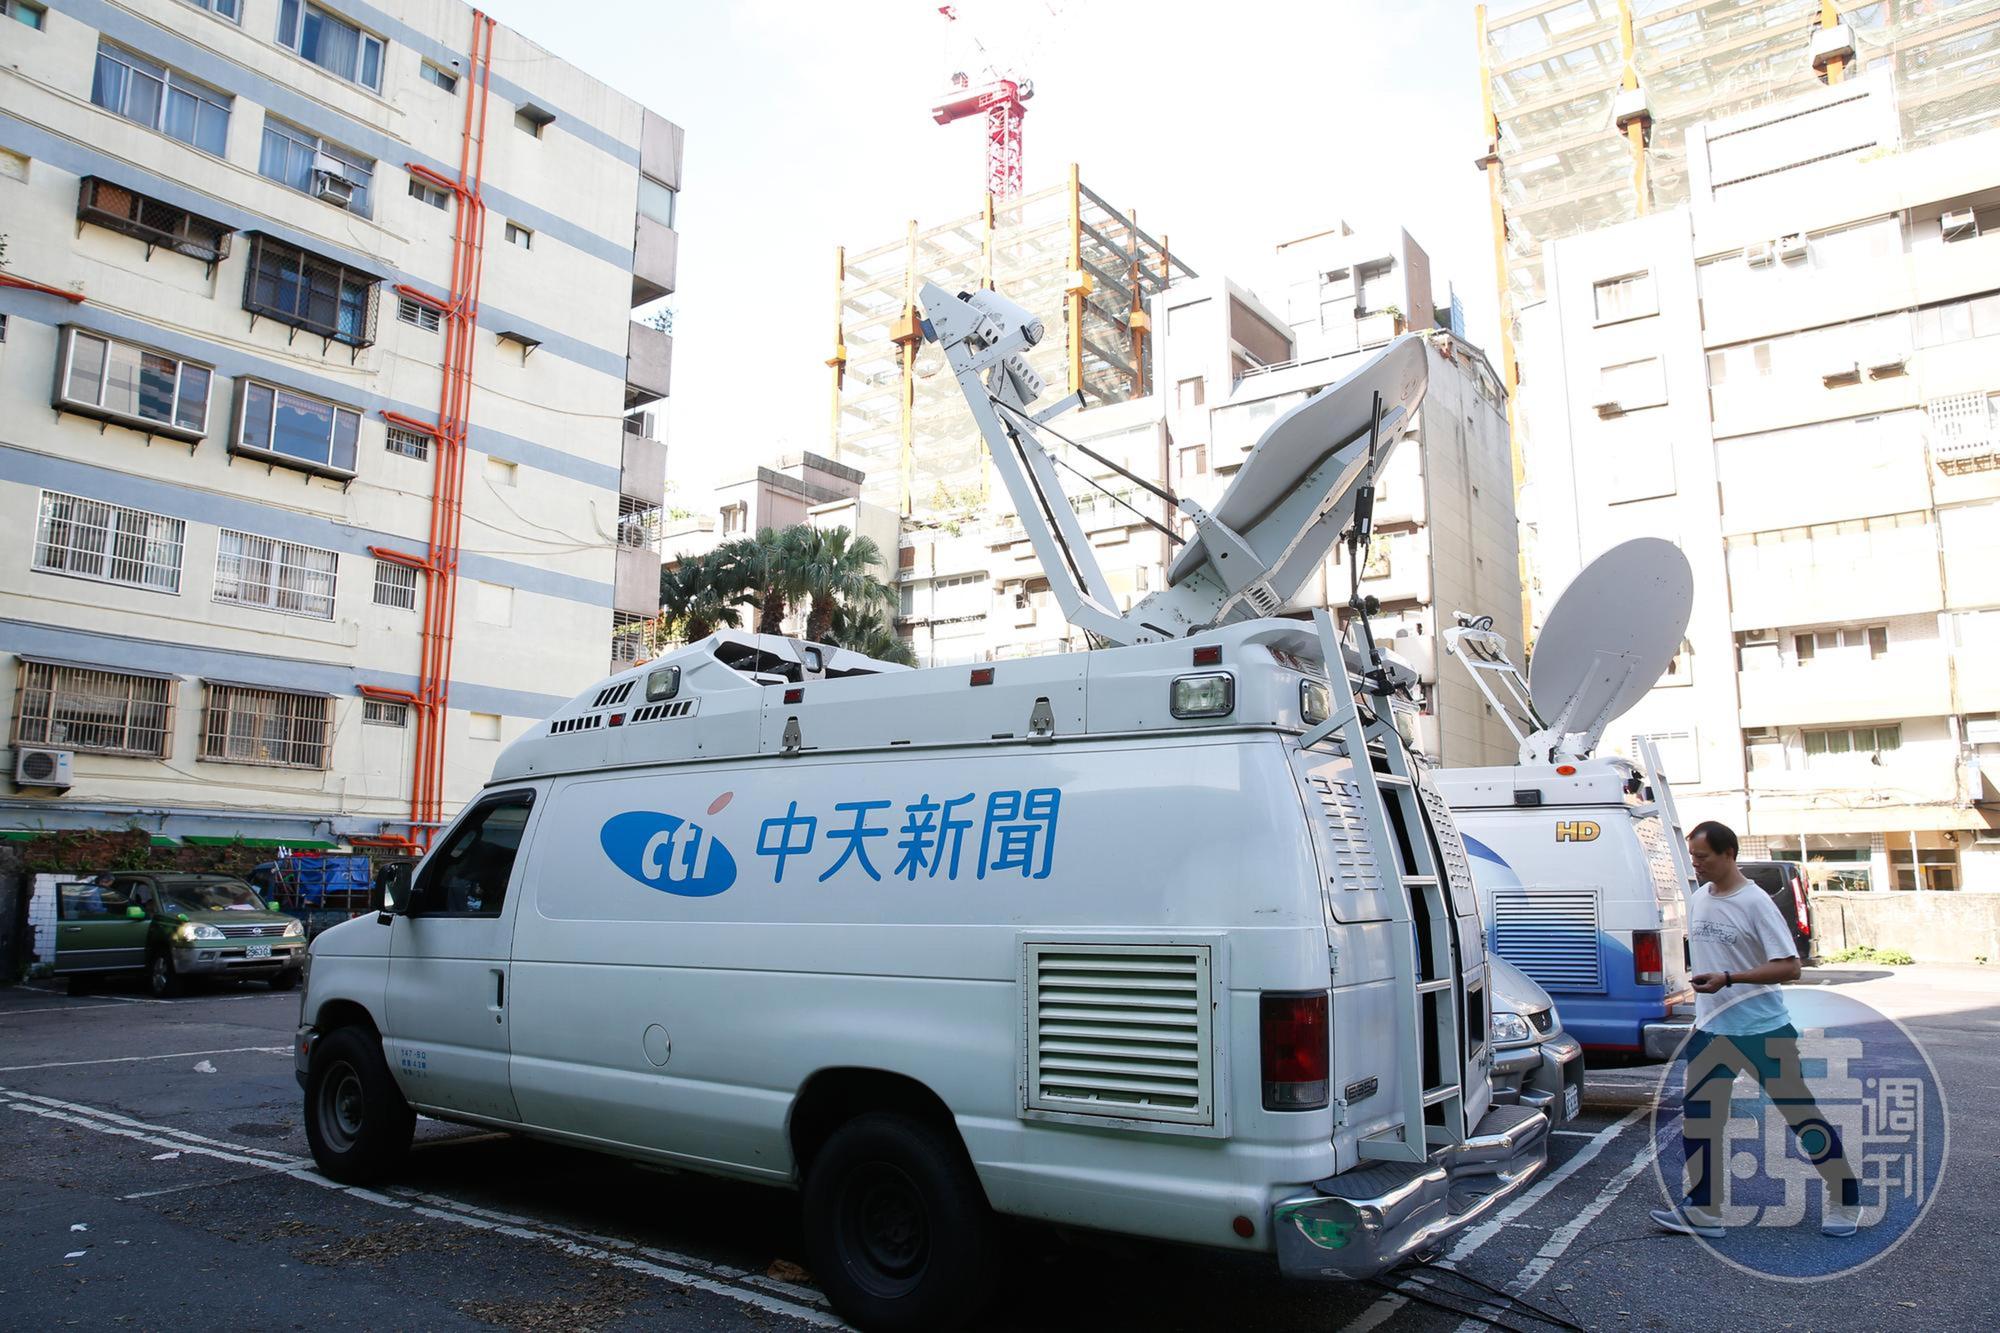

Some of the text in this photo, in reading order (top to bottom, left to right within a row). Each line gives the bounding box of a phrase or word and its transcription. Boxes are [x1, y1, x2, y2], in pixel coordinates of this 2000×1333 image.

[756, 787, 1062, 883] 中天新聞
[1556, 820, 1601, 842] HD
